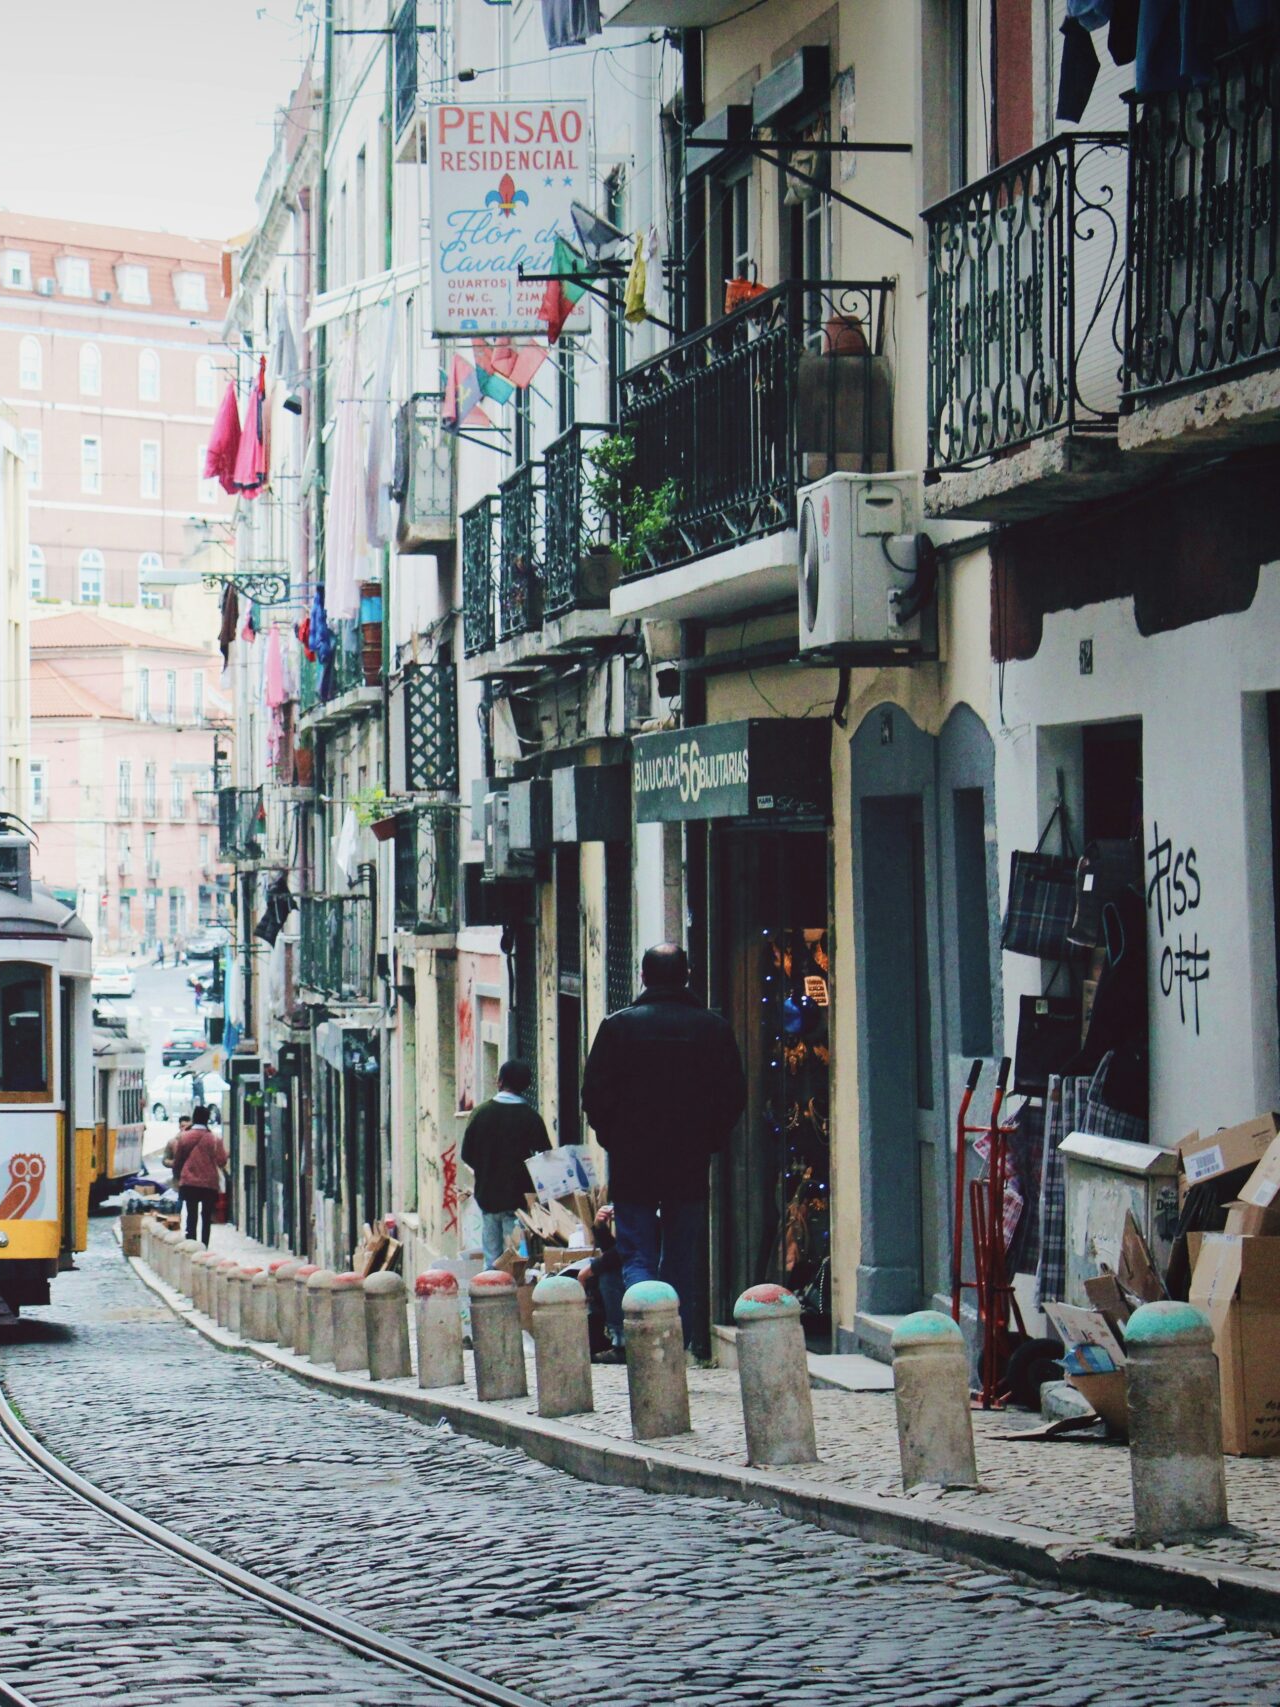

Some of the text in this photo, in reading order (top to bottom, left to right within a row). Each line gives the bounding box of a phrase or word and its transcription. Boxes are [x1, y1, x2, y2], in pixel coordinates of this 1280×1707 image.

[441, 150, 579, 171] RESIDENCIAL
[447, 208, 521, 245] Flor
[448, 279, 507, 289] QUARTOS
[679, 740, 701, 803] 56
[699, 749, 749, 789] BIJUTARIAS
